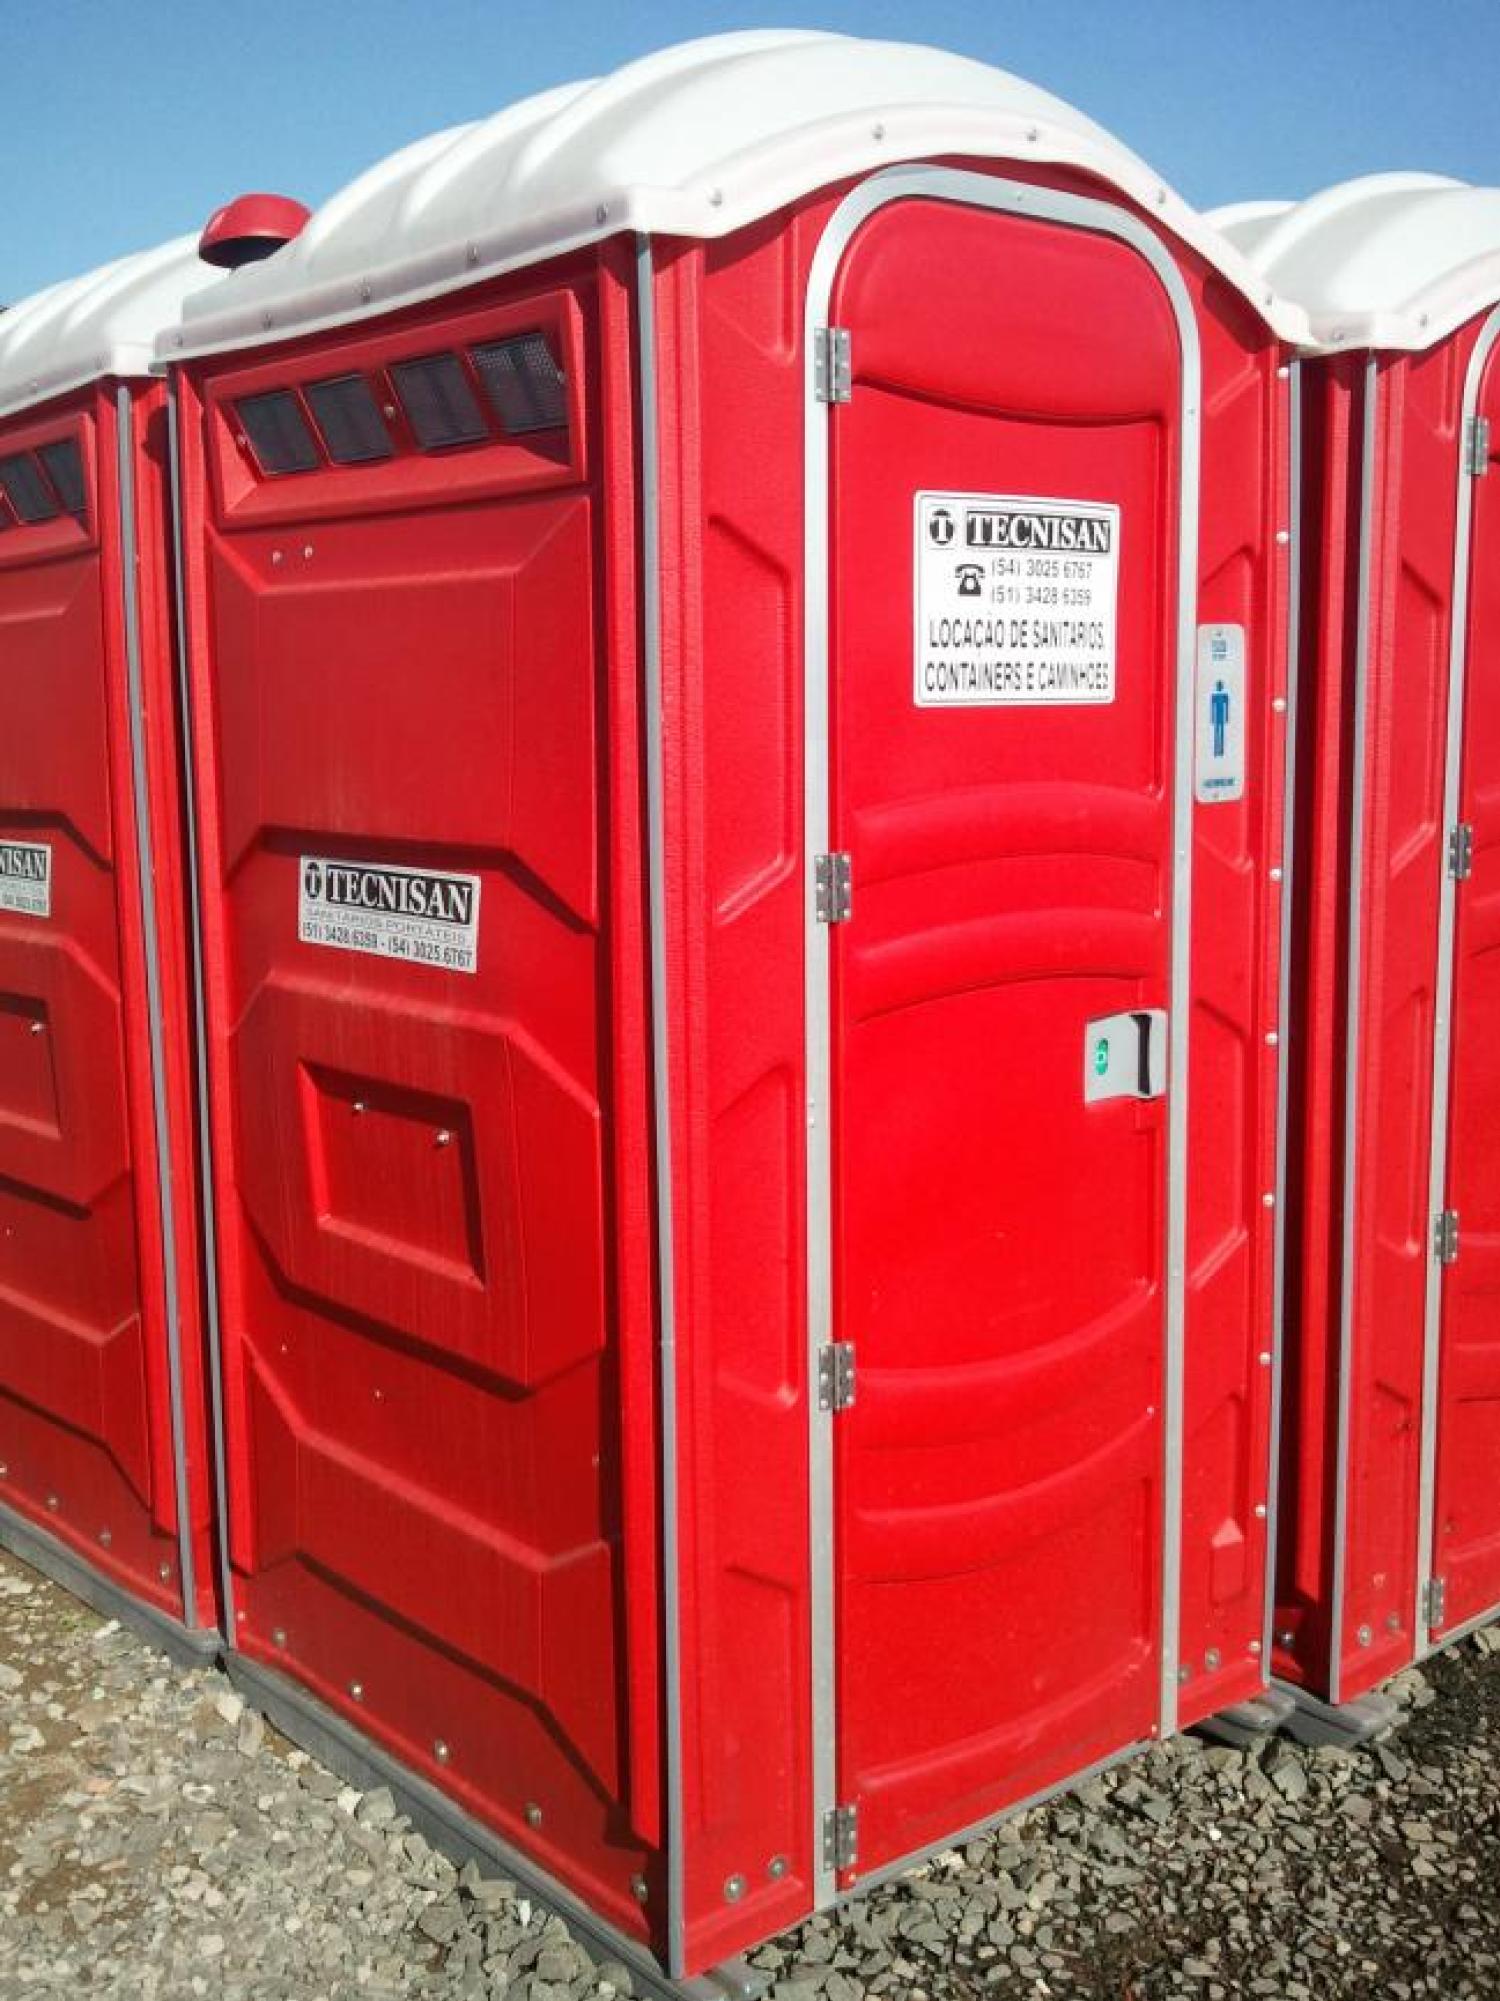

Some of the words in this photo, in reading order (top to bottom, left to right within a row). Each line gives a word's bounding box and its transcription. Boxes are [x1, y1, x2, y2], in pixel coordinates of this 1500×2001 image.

[967, 514, 1110, 552] TECNISAN
[991, 559, 1020, 578] (54)
[1026, 560, 1058, 578] 3025
[991, 585, 1020, 604] (51)
[1026, 586, 1058, 605] 3428
[1010, 619, 1028, 648] DE
[925, 662, 1021, 691] CONTAINERS
[1027, 662, 1035, 691] E
[326, 866, 473, 924] TECNISAN
